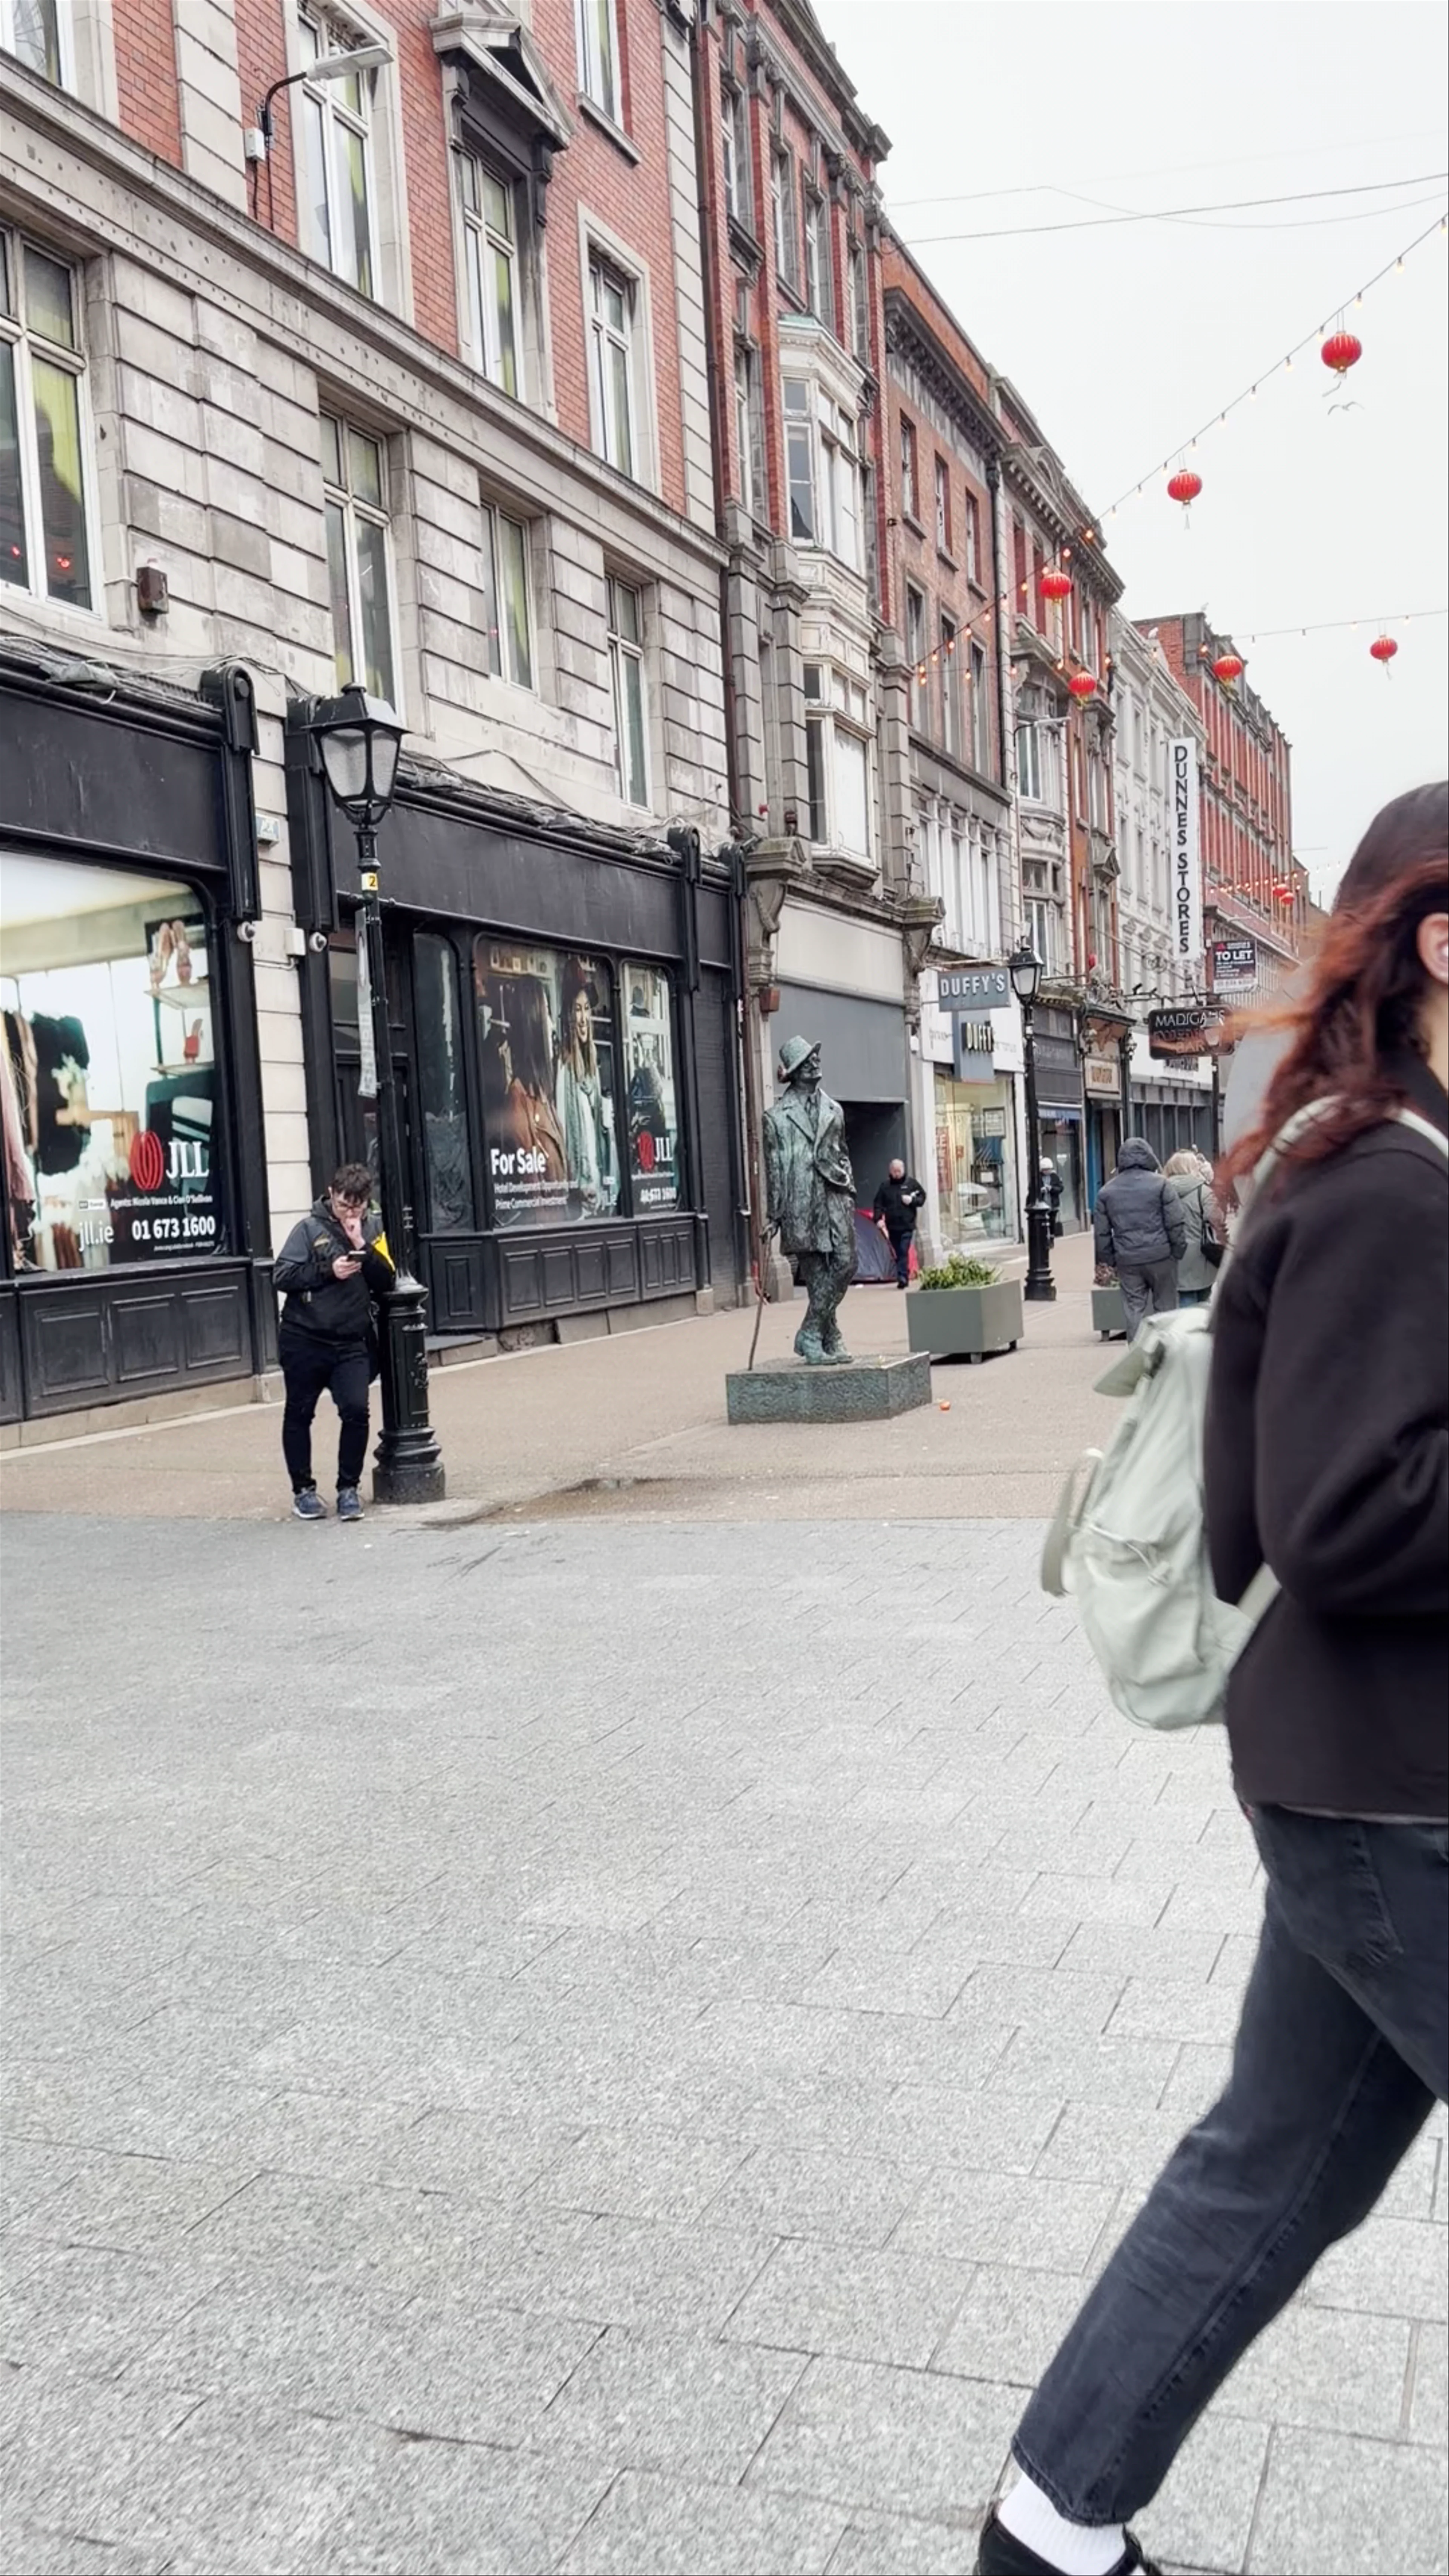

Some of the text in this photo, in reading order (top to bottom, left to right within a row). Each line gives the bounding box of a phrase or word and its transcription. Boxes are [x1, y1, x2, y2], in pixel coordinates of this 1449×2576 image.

[1174, 745, 1190, 953] DUNNES STORES
[369, 875, 376, 887] 2
[1215, 949, 1252, 961] TO LET
[941, 973, 1005, 997] DUFFY'S
[166, 1141, 209, 1179] JLL
[491, 1146, 546, 1175] For Sale
[654, 1137, 674, 1162] JLL
[79, 1220, 114, 1252] jll.ie
[132, 1215, 215, 1240] 01 673 1600
